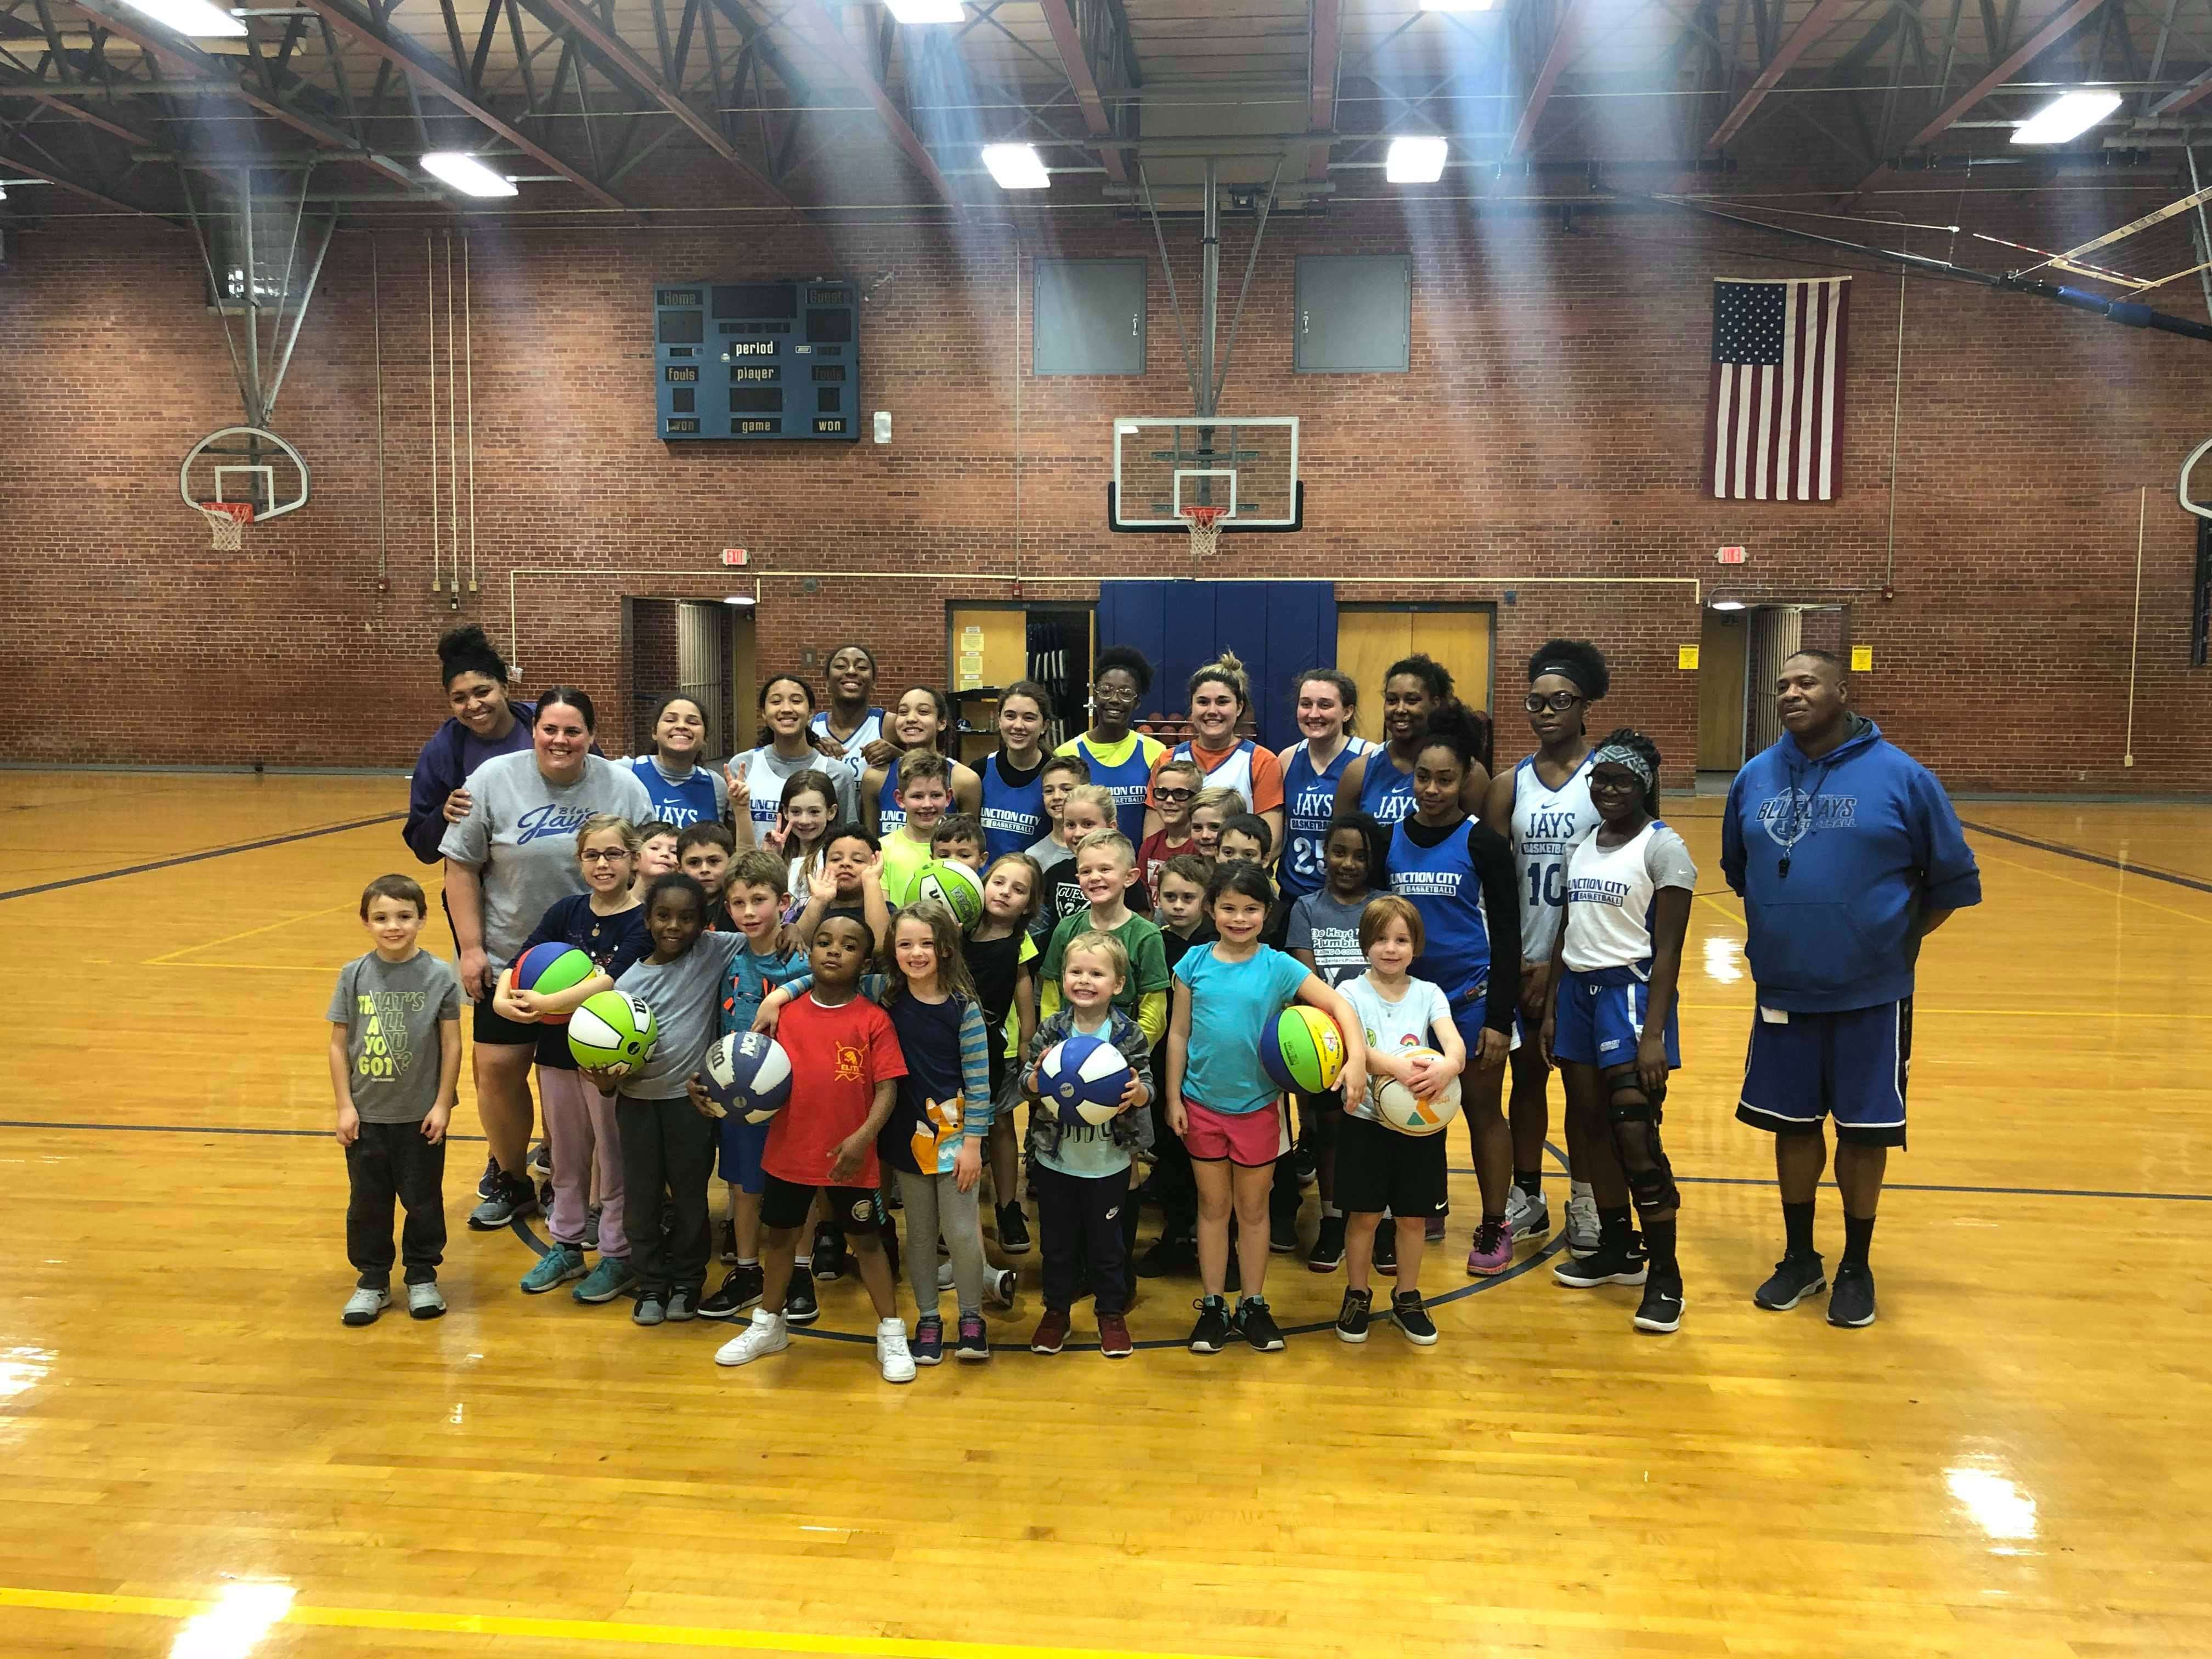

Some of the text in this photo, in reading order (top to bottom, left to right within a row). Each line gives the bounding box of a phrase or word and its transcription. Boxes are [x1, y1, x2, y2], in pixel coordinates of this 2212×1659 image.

[664, 291, 696, 304] Home
[736, 340, 774, 357] period
[669, 367, 695, 381] fouls
[737, 366, 775, 381] player
[742, 420, 771, 433] game
[819, 420, 841, 431] won
[726, 550, 744, 563] EXIT
[559, 806, 591, 815] Blue
[749, 799, 779, 811] UNCT
[1293, 793, 1334, 817] JAYS
[879, 810, 907, 822] JUNCT
[980, 807, 1041, 826] UNCTION CITY
[991, 820, 1032, 833] BASKETBALL
[1291, 820, 1328, 830] BASKETBA
[1525, 812, 1576, 839] JAYS
[1523, 843, 1563, 854] BASKETB
[1389, 872, 1463, 885] JUNCTION CITY
[1527, 862, 1568, 907] 10
[1406, 885, 1453, 894] BASKETBALL
[1568, 878, 1632, 896] UNCTION CITY
[1579, 893, 1620, 905] BASKETBALL
[1326, 927, 1354, 938] Hart
[1312, 938, 1360, 949] Plumbin
